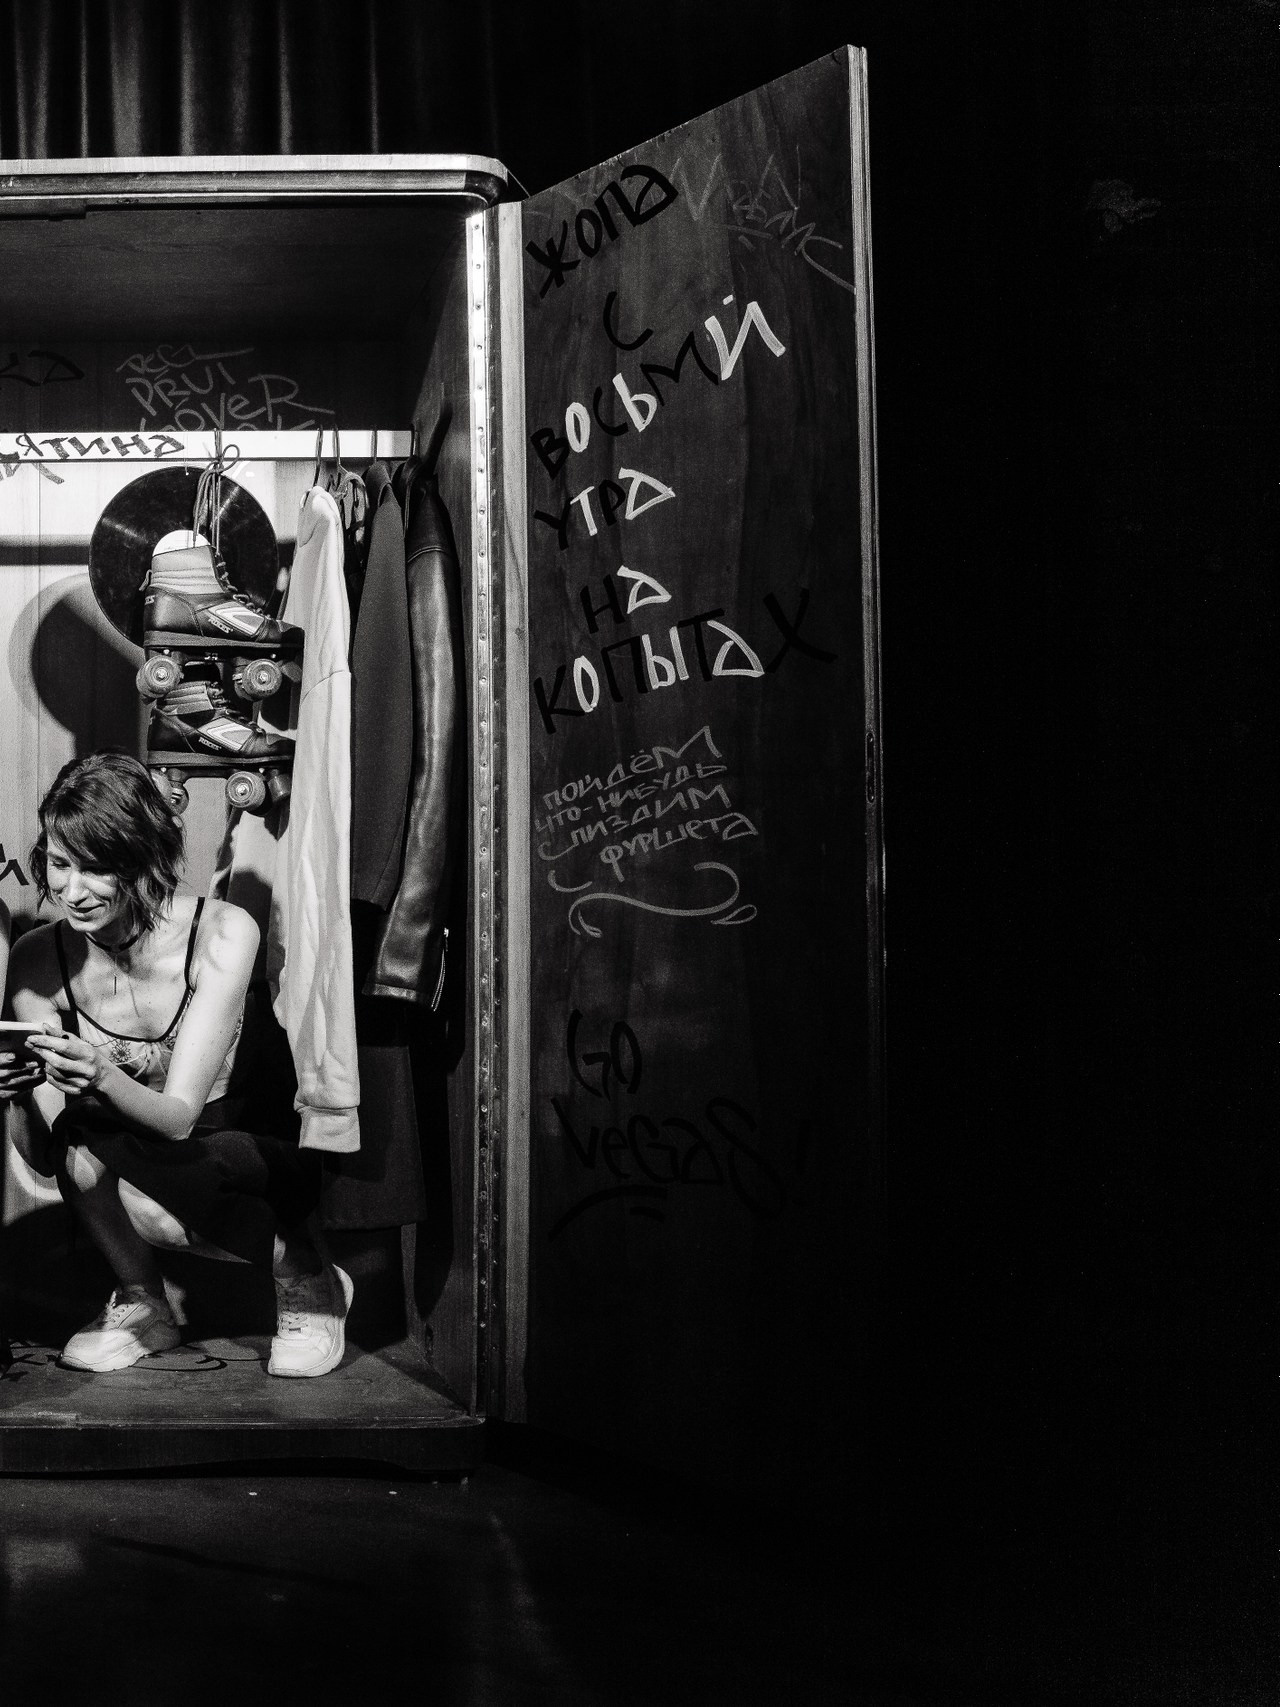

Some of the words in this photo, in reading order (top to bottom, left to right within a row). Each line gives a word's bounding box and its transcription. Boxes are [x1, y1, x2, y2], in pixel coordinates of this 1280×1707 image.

[525, 164, 679, 299] ЖОПА
[602, 291, 654, 351] С
[534, 467, 676, 551] УТРА
[579, 565, 672, 634] НА
[533, 588, 838, 735] КОПЫТАХ
